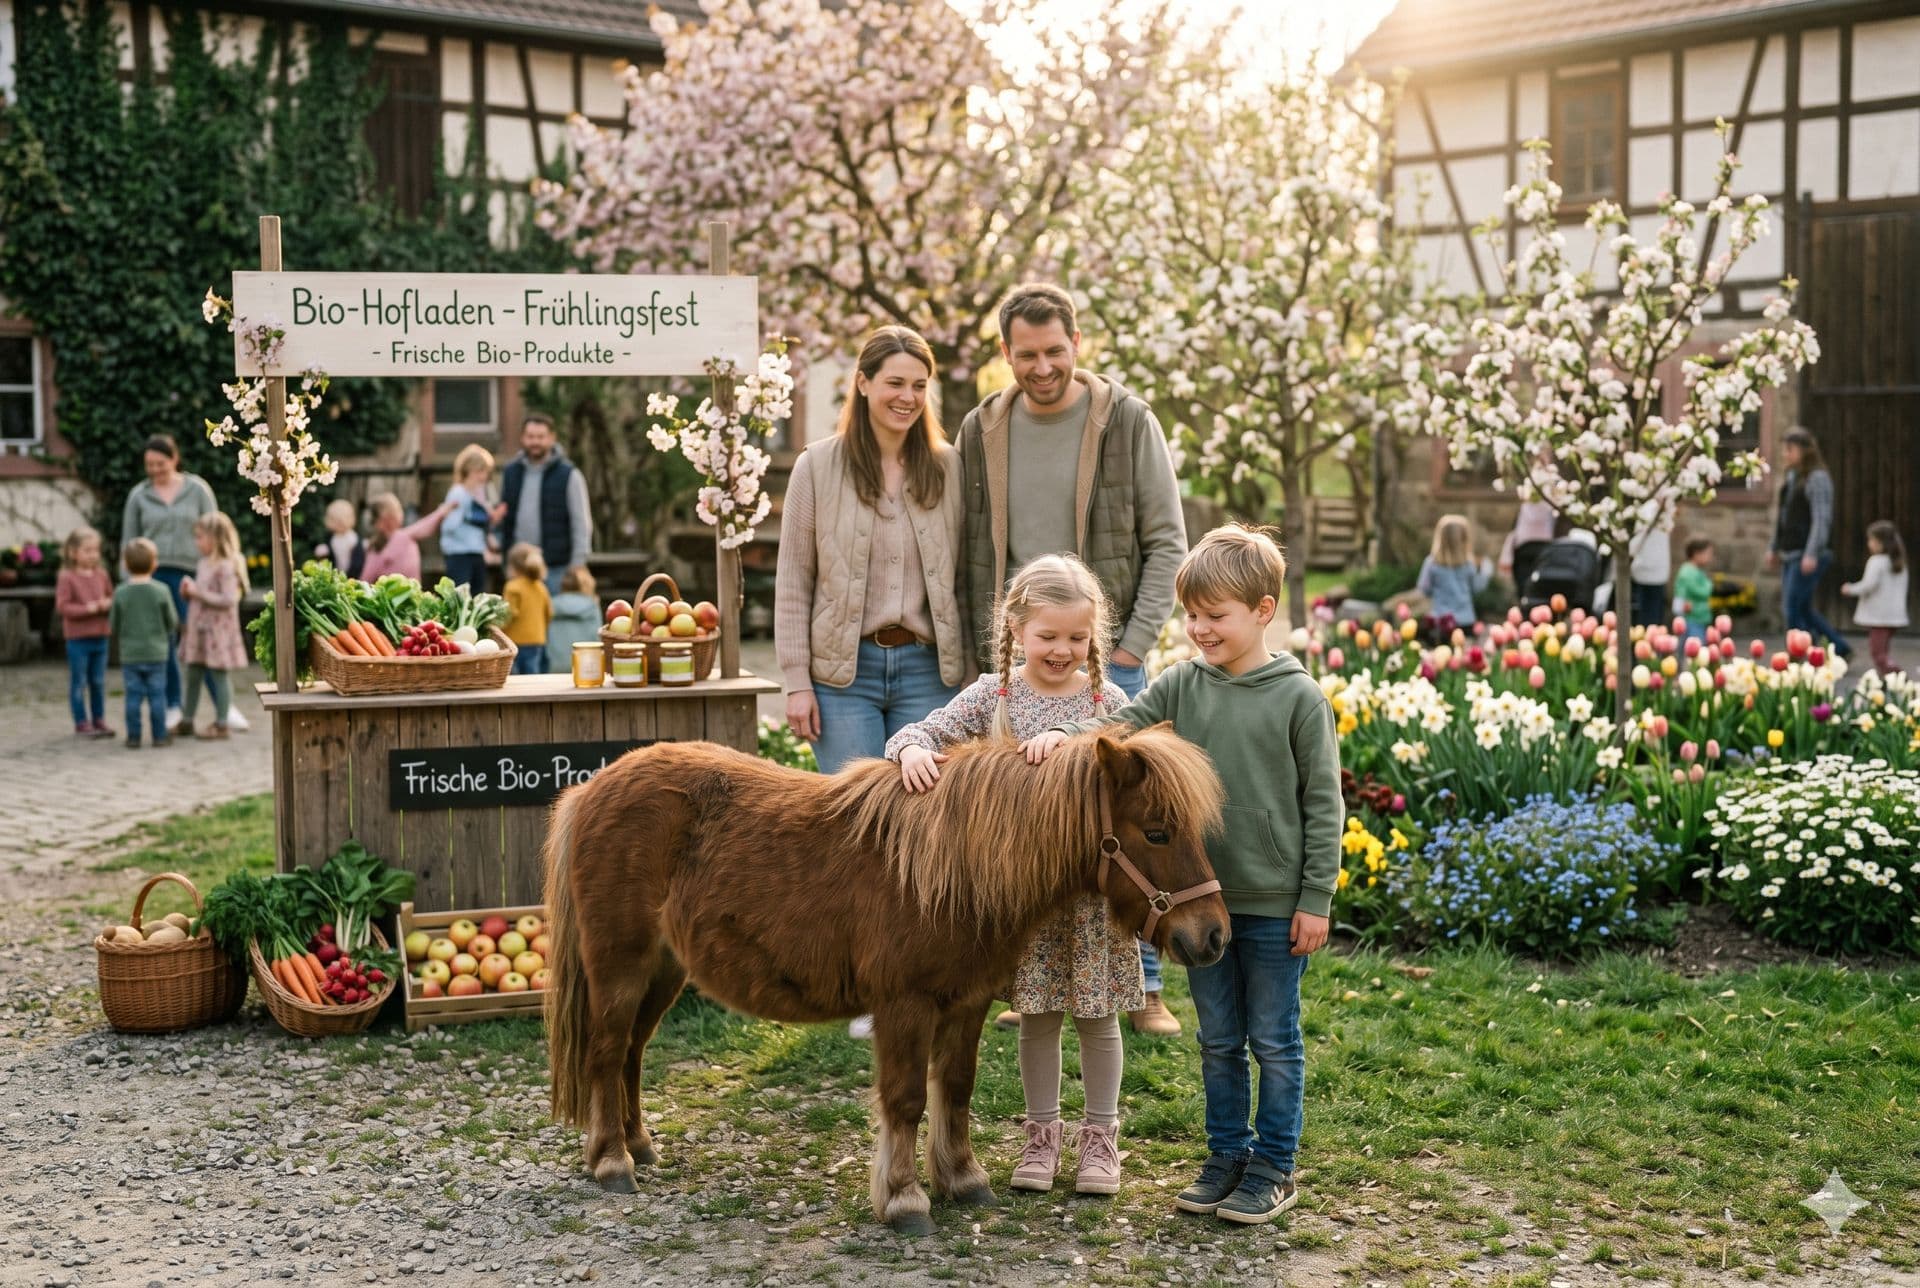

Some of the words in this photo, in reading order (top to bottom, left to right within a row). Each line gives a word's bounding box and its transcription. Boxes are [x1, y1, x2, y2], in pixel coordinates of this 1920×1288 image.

[292, 286, 495, 335] Bio-Hofladen
[524, 289, 700, 339] Frühlingsfest
[391, 340, 465, 365] Frische
[477, 340, 615, 365] Bio-Produkte
[400, 760, 488, 795] Frische
